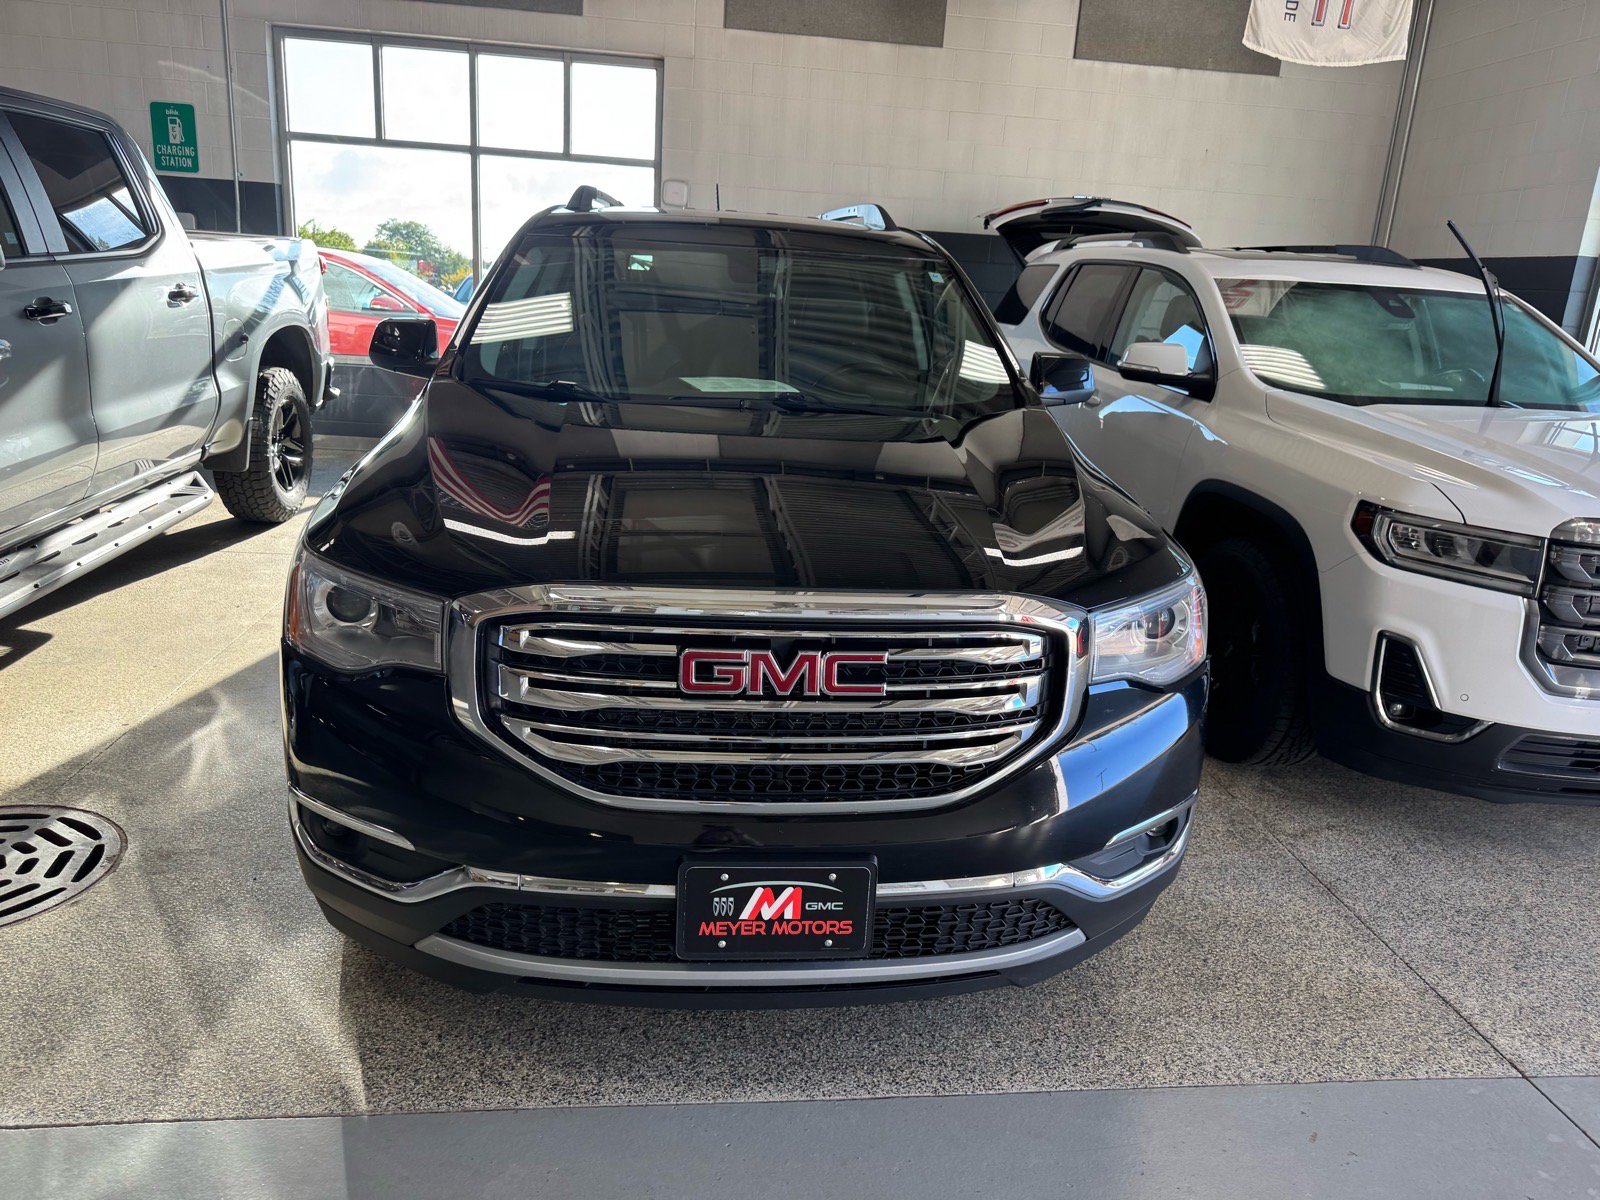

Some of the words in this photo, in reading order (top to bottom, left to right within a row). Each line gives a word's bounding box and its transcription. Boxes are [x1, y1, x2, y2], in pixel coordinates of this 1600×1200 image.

[156, 144, 195, 157] CHARGING
[160, 156, 193, 168] STATION
[679, 648, 889, 696] GMC
[805, 902, 844, 911] GMC
[698, 921, 766, 936] MEYER
[771, 920, 853, 935] MOTORS
